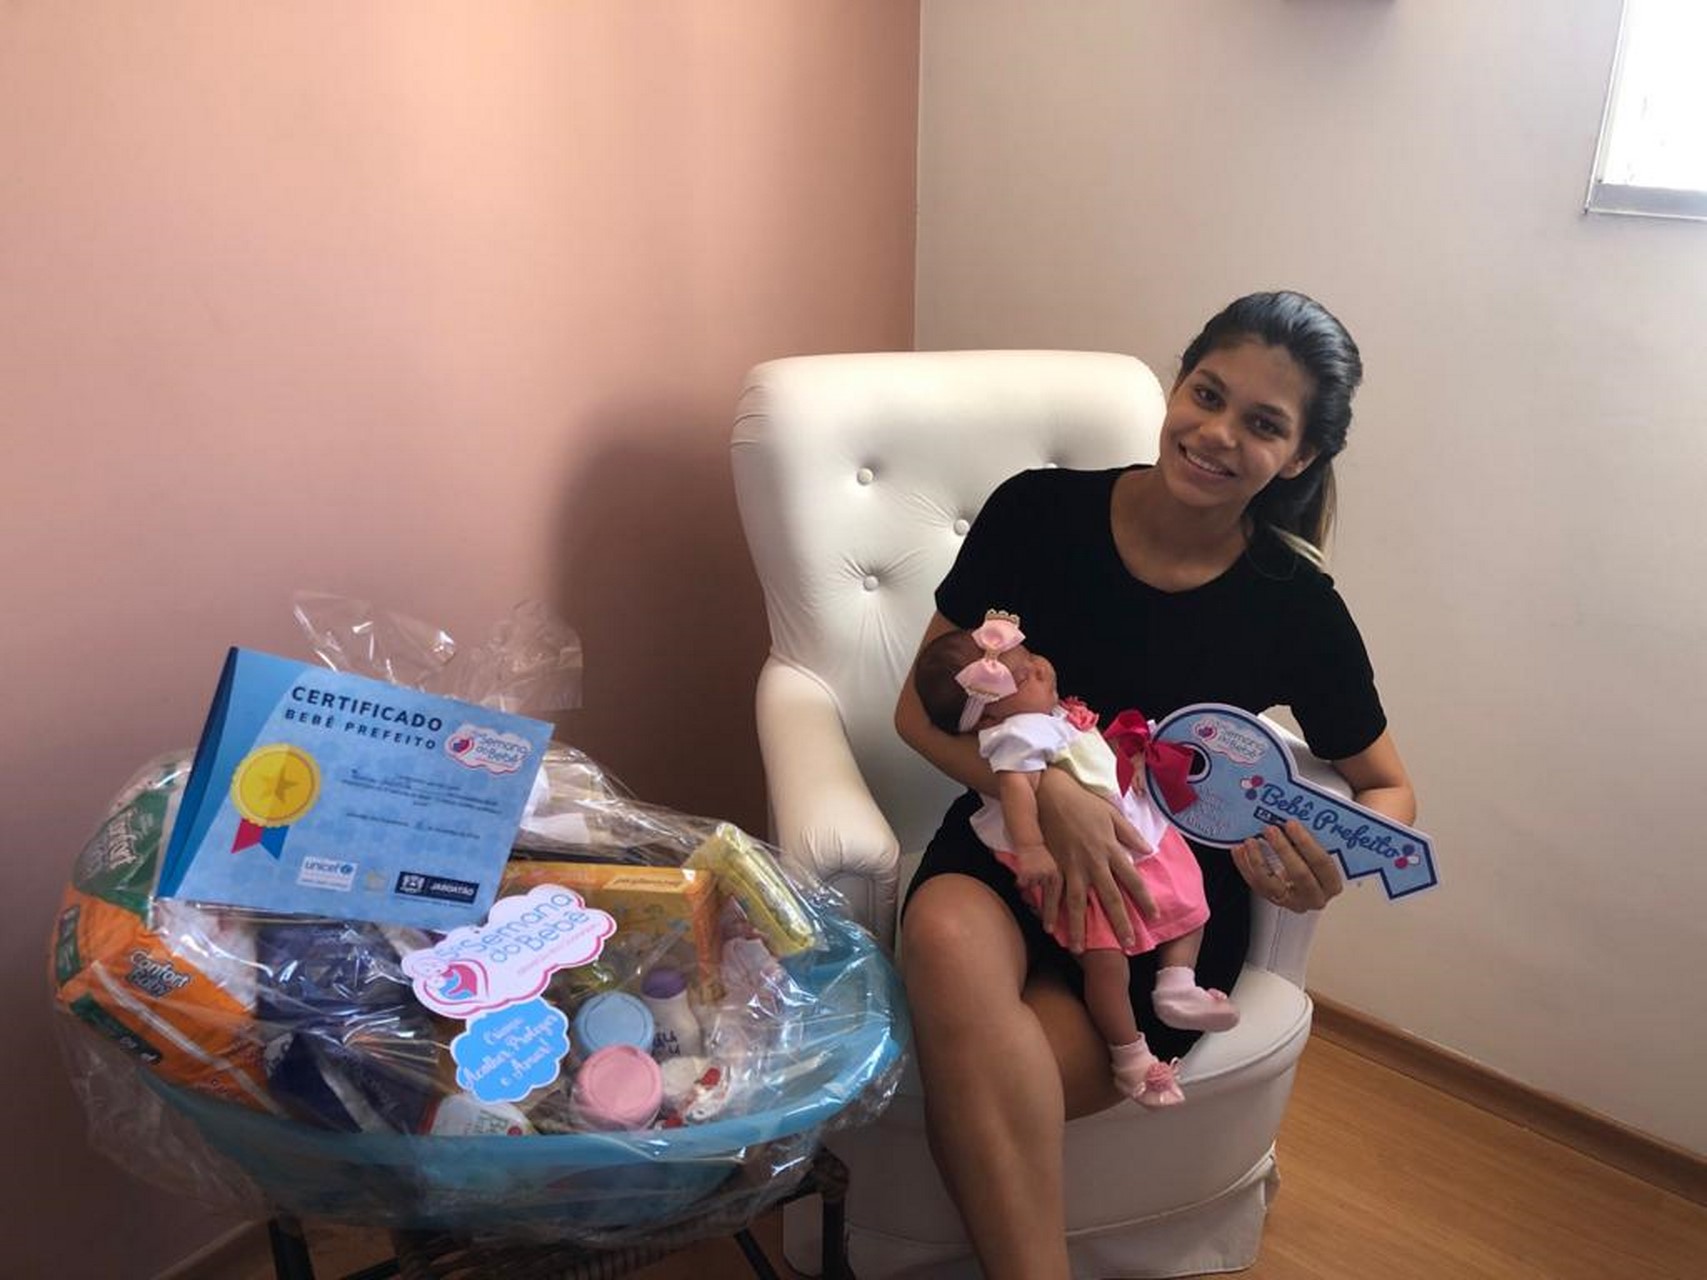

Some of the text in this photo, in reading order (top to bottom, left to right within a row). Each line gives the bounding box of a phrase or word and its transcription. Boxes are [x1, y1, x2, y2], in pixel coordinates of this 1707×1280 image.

[284, 709, 436, 750] BEBÊ PREFEITO
[292, 686, 443, 732] CERTIFICADO
[1261, 783, 1314, 822] Bebê
[1312, 809, 1399, 859] Prefeito
[304, 861, 340, 873] unicef
[459, 893, 574, 954] Semana
